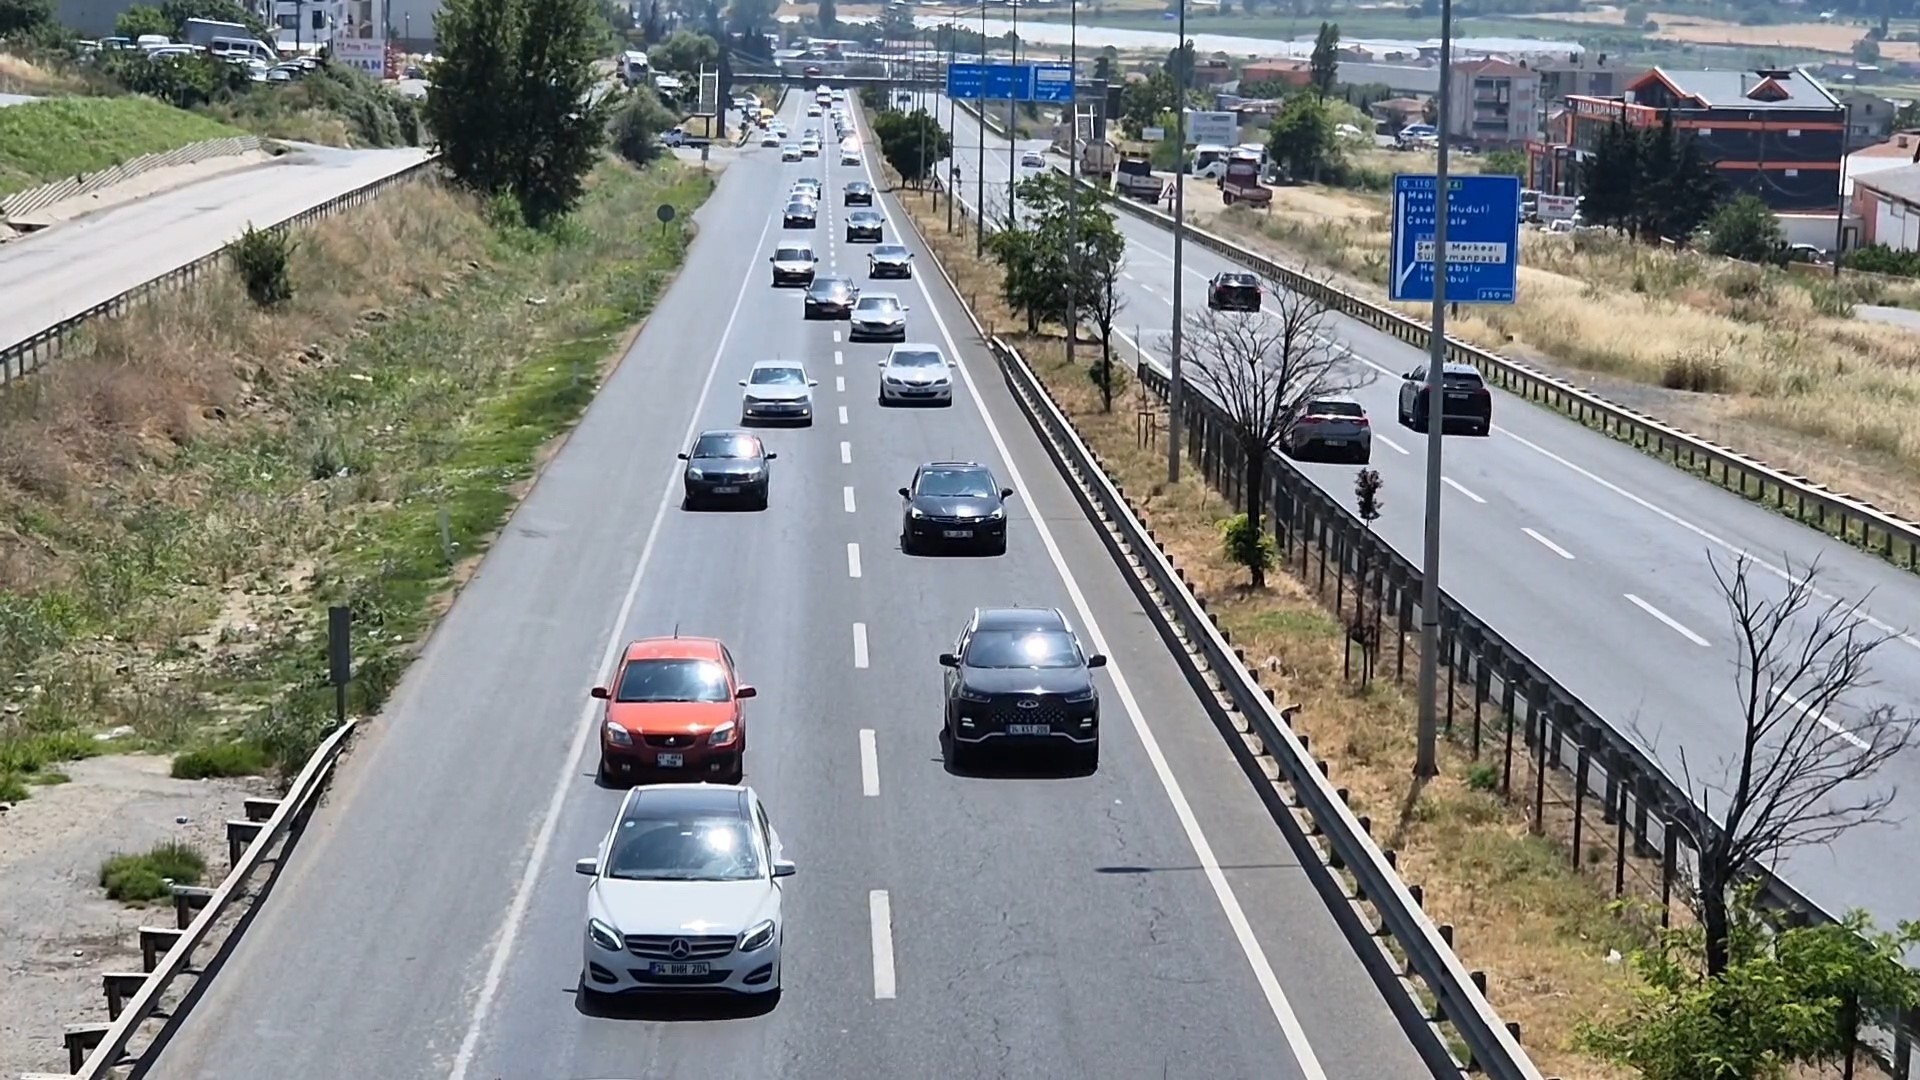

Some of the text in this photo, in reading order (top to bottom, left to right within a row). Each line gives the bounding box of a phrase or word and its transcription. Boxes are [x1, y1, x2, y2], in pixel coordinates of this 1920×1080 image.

[1407, 191, 1454, 200] Malka
[1407, 202, 1436, 214] İpsal
[1407, 215, 1467, 226] Çanaale
[1452, 243, 1498, 252] Merkezi
[1420, 264, 1481, 272] Haabolu
